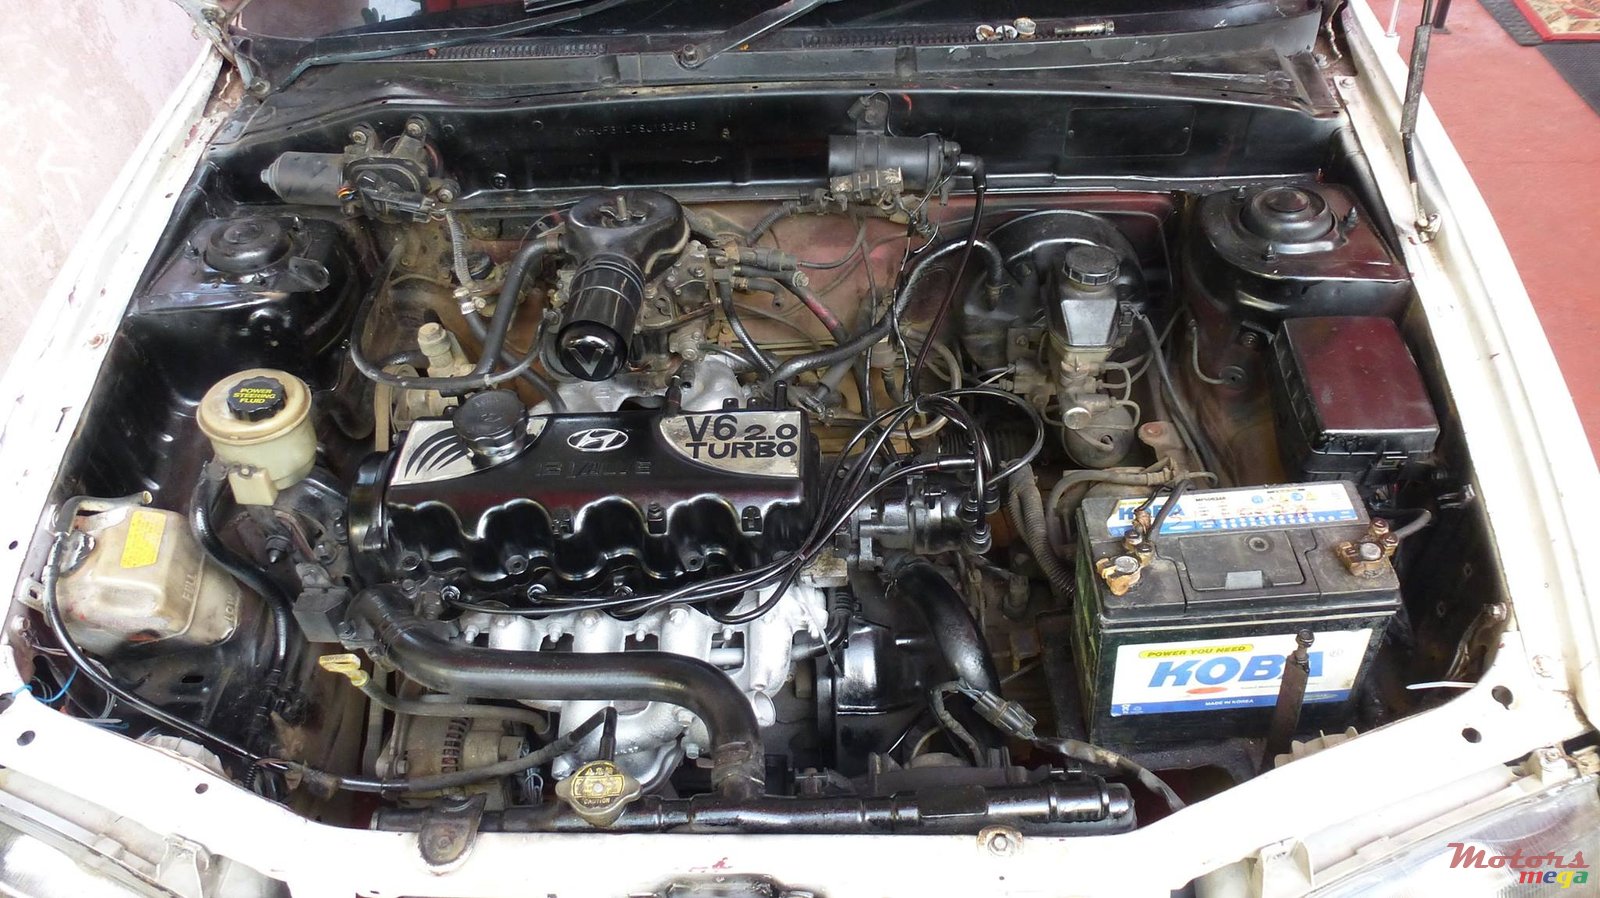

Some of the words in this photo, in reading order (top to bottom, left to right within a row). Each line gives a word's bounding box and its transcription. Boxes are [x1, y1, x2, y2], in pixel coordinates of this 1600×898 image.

[685, 414, 738, 442] V6
[744, 424, 798, 440] 2.0
[685, 441, 798, 459] TURBO
